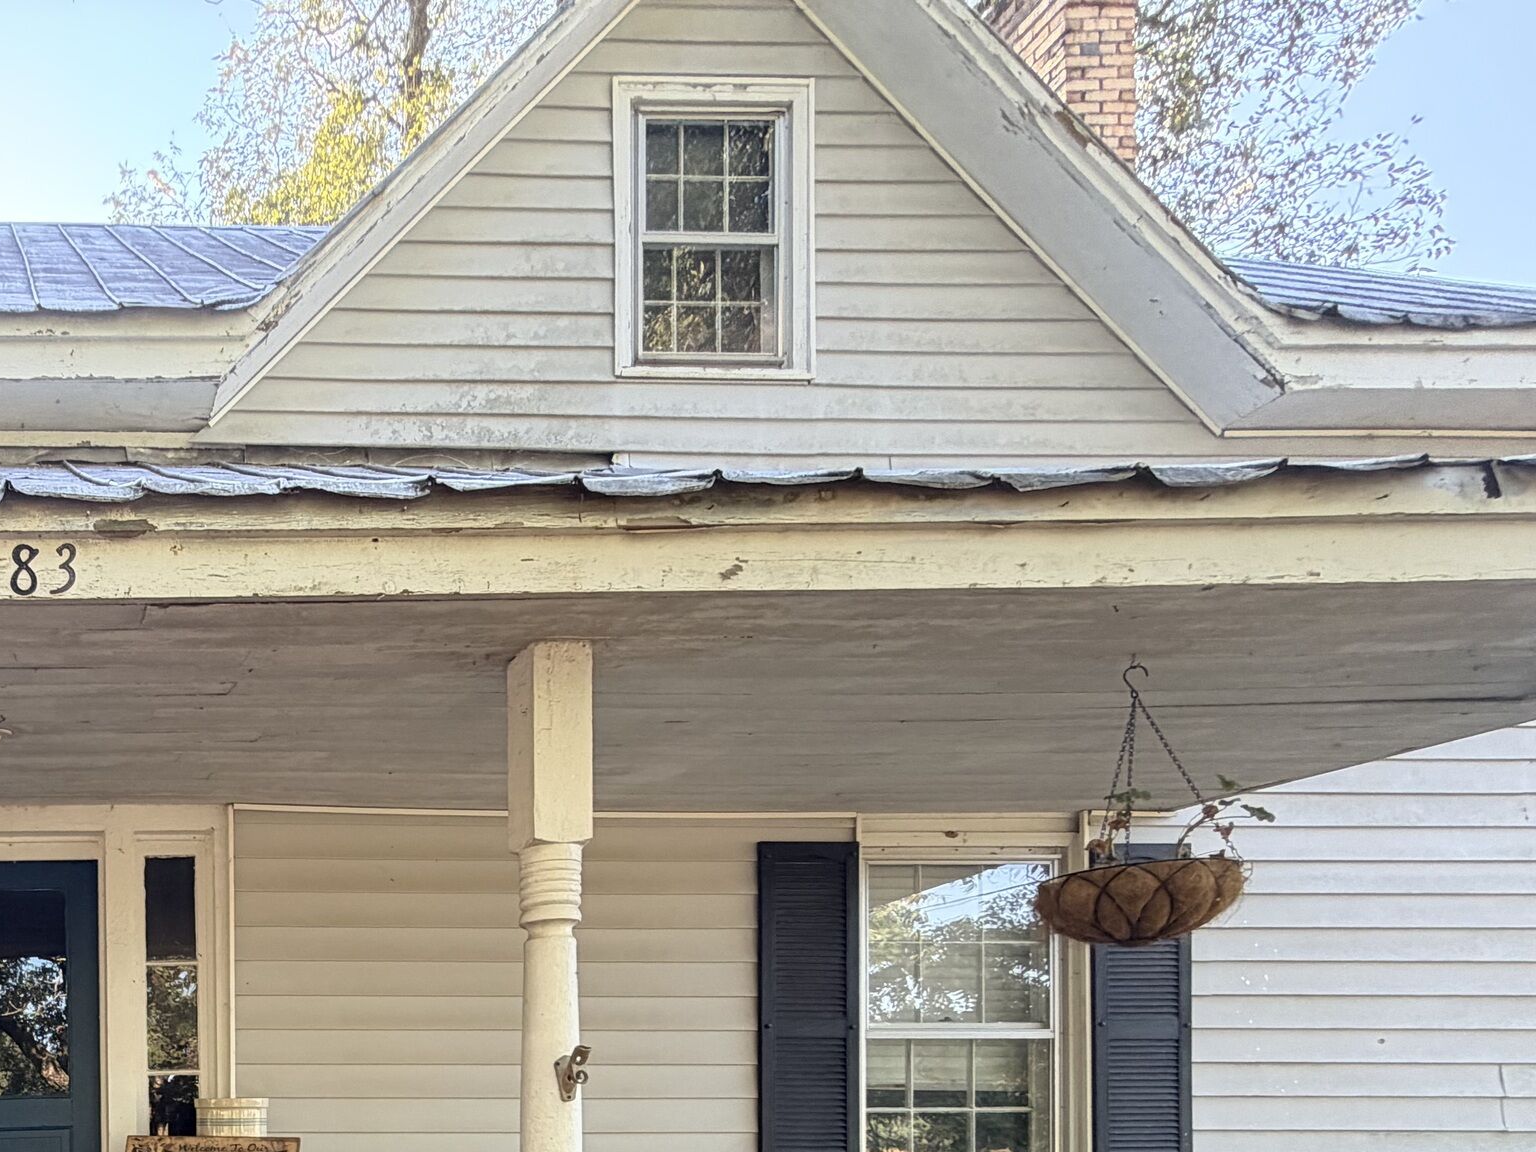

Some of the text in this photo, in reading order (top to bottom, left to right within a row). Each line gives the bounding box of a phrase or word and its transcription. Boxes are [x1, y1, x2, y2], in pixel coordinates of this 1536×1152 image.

[178, 1142, 270, 1152] Welcome To Our
